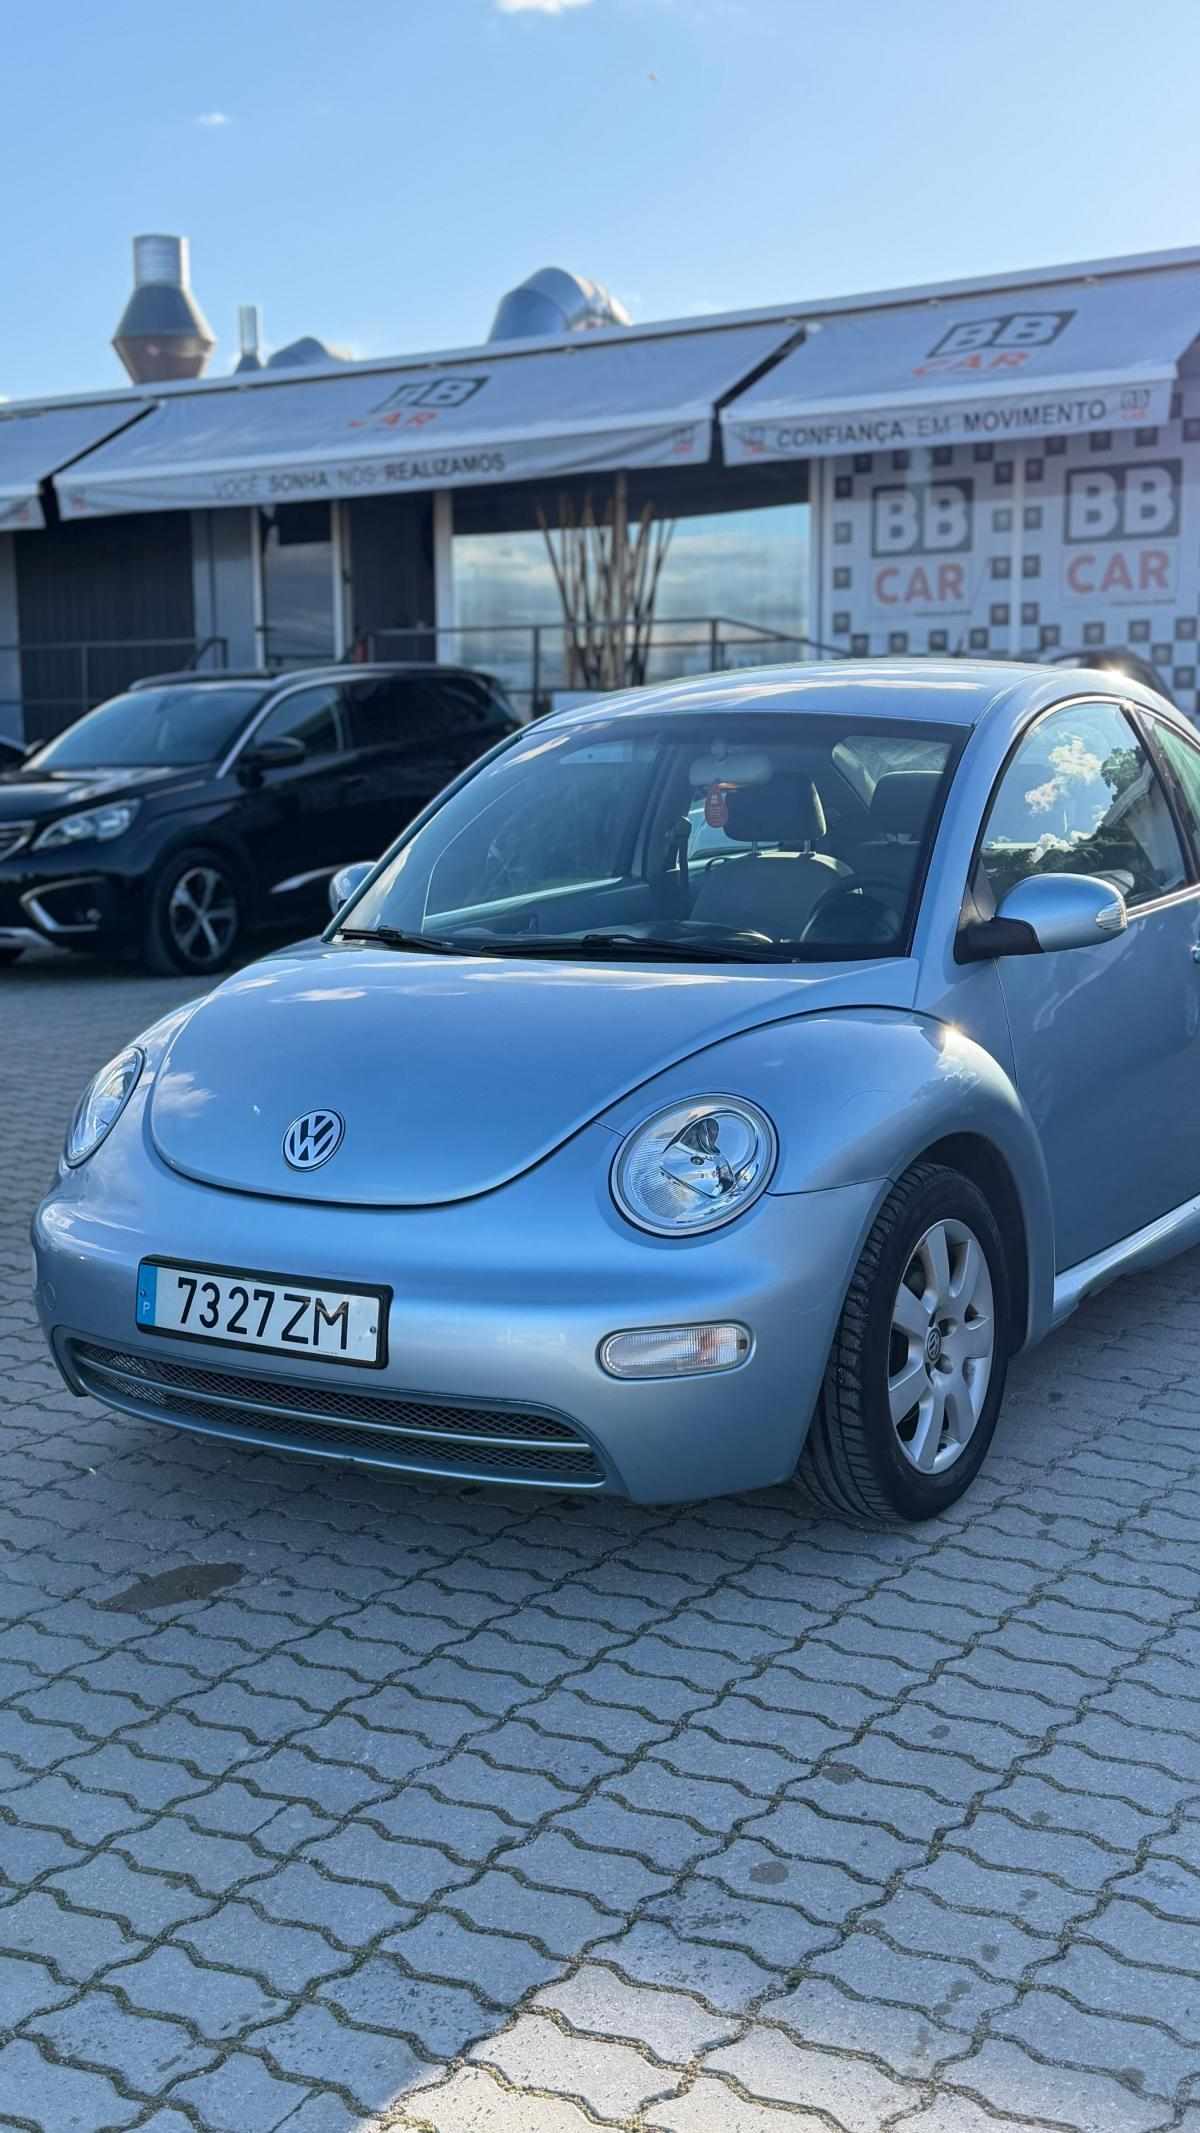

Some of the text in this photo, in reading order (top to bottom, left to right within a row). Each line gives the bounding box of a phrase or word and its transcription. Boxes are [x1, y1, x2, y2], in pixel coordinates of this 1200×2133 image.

[775, 419, 905, 450] CONFIANÇA
[917, 417, 952, 438] EM
[963, 399, 1107, 433] MOVIMENTO
[269, 470, 329, 493] SONHA
[383, 452, 506, 482] REALIZAMOS
[874, 484, 971, 552] BB
[1066, 466, 1176, 542] BB
[874, 562, 965, 605] CAR
[1066, 549, 1171, 594] CAR
[143, 1302, 151, 1314] P
[177, 1276, 349, 1350] 7327ZM
